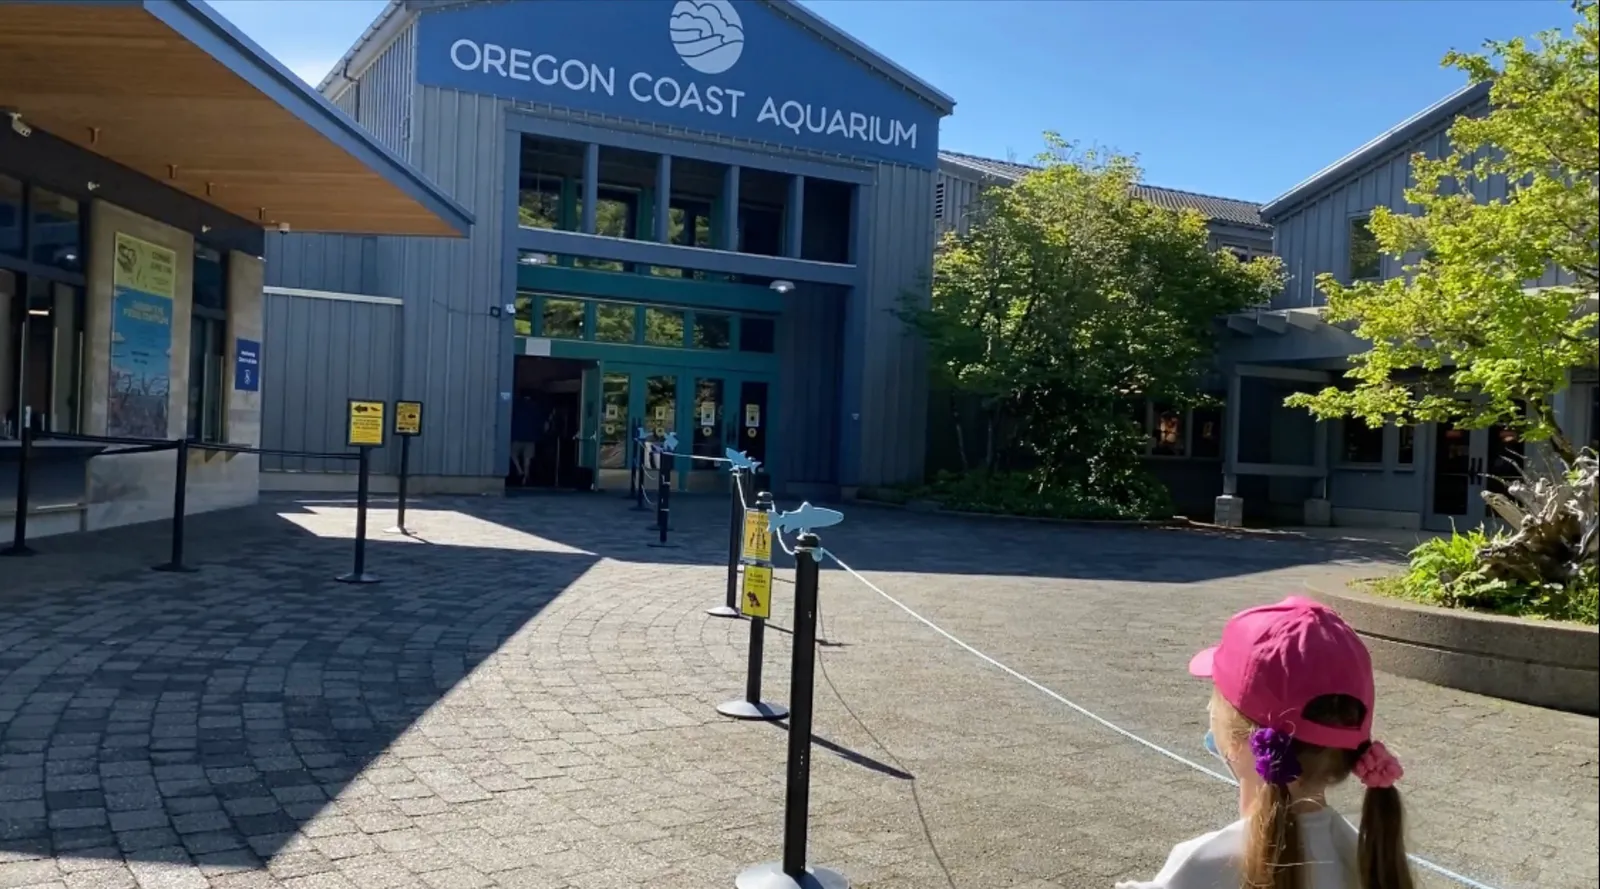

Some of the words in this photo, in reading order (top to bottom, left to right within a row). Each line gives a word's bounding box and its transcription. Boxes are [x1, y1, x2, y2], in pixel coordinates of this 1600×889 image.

[450, 39, 615, 96] OREGON
[629, 72, 745, 118] COAST
[757, 96, 917, 149] AQUARIUM
